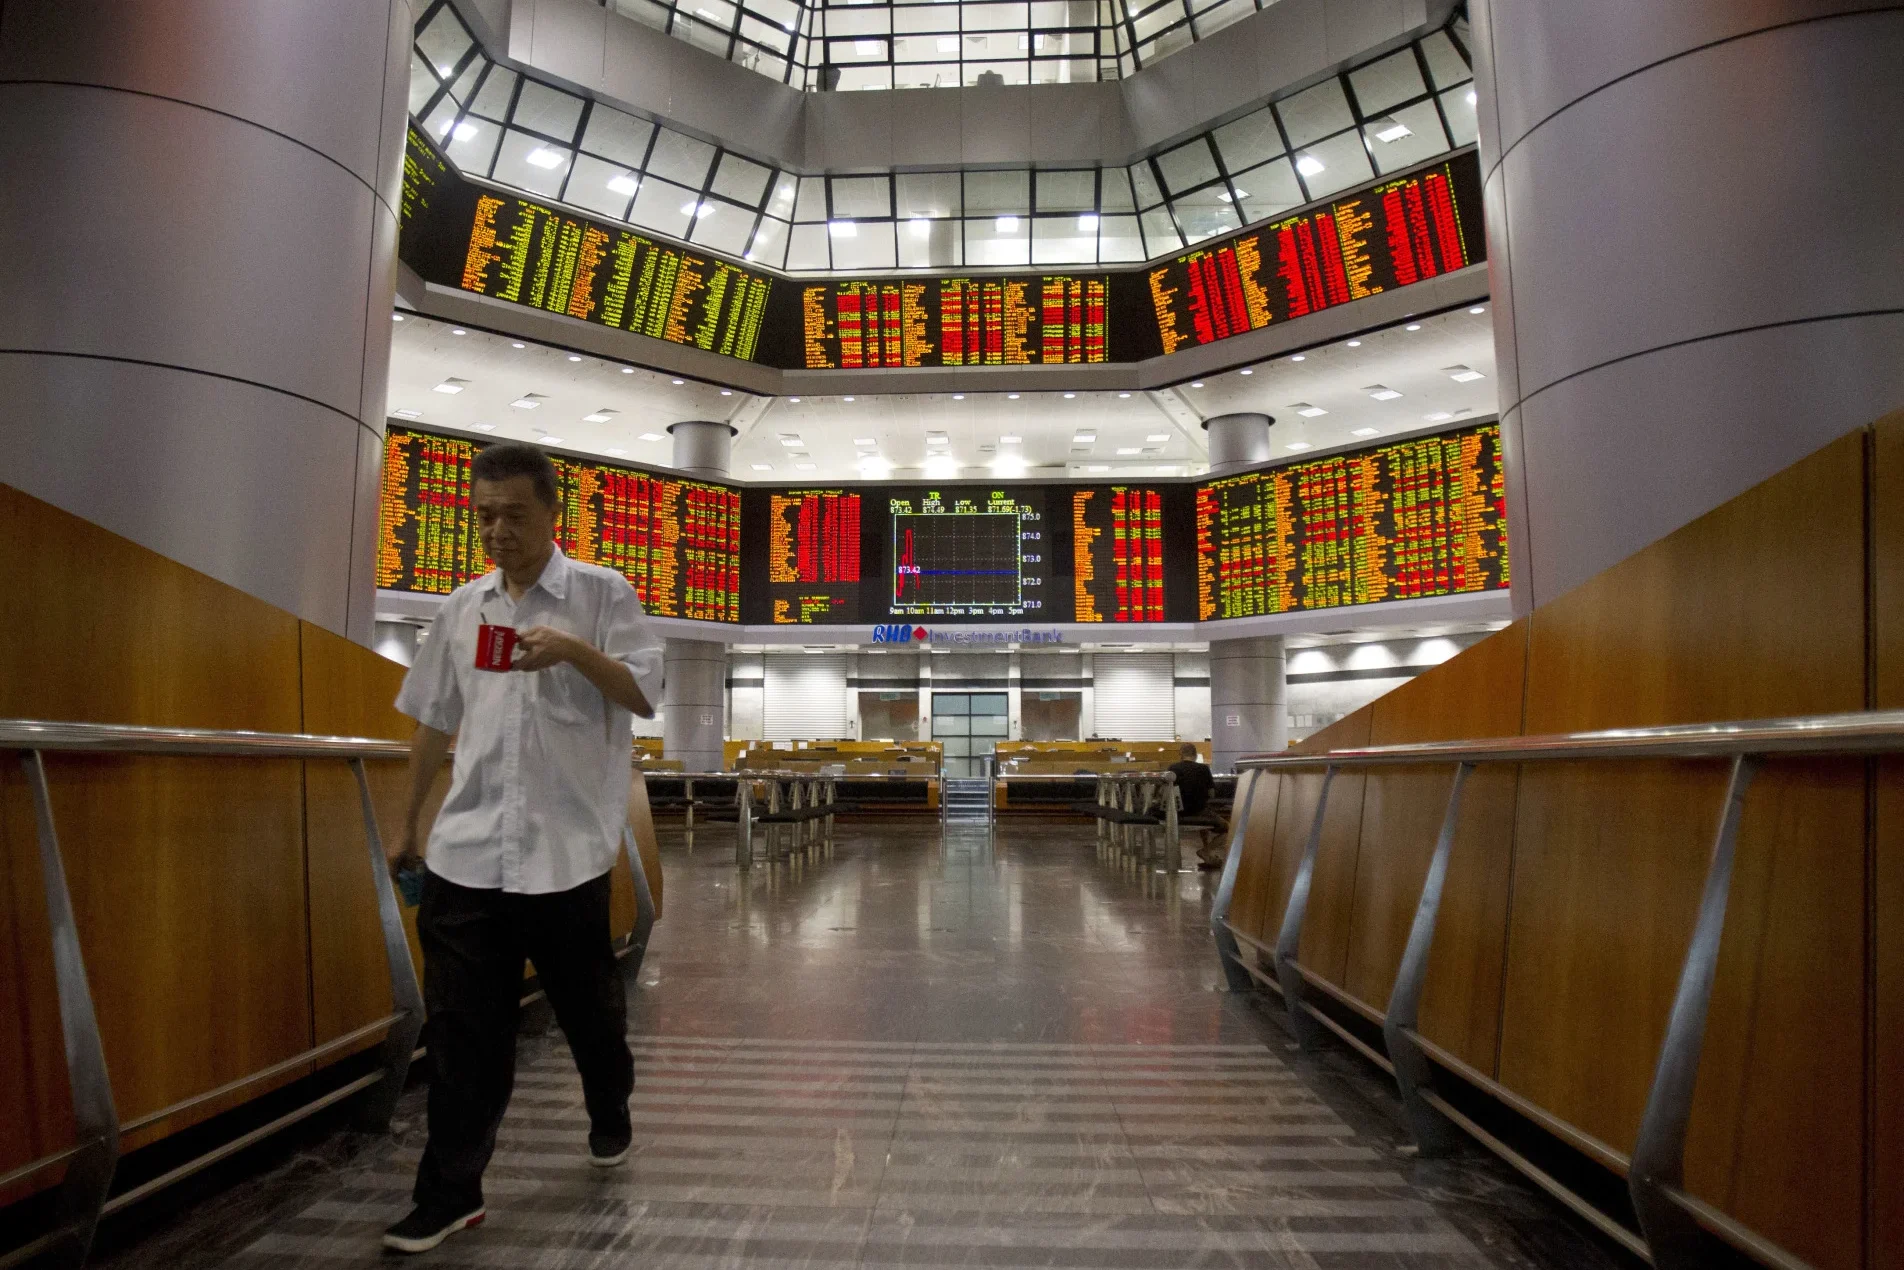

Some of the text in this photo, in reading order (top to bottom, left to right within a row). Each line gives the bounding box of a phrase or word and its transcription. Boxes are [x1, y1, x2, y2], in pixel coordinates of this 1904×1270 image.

[991, 491, 1005, 499] ON
[890, 498, 910, 508] Open
[922, 498, 941, 508] High
[890, 506, 912, 514] 873.42
[922, 505, 945, 514] 874.49
[955, 505, 978, 513] 871.35
[1022, 512, 1041, 520] 875.0
[1022, 532, 1041, 540] 874.0
[1022, 554, 1042, 563] 873.0
[898, 565, 921, 574] 873.42
[1022, 577, 1042, 586] 872.0
[1022, 600, 1042, 608] 871.0
[889, 606, 1024, 616] 9am 10am 11am 12pm 3pm 4pm 5pm
[872, 624, 913, 643] RHB
